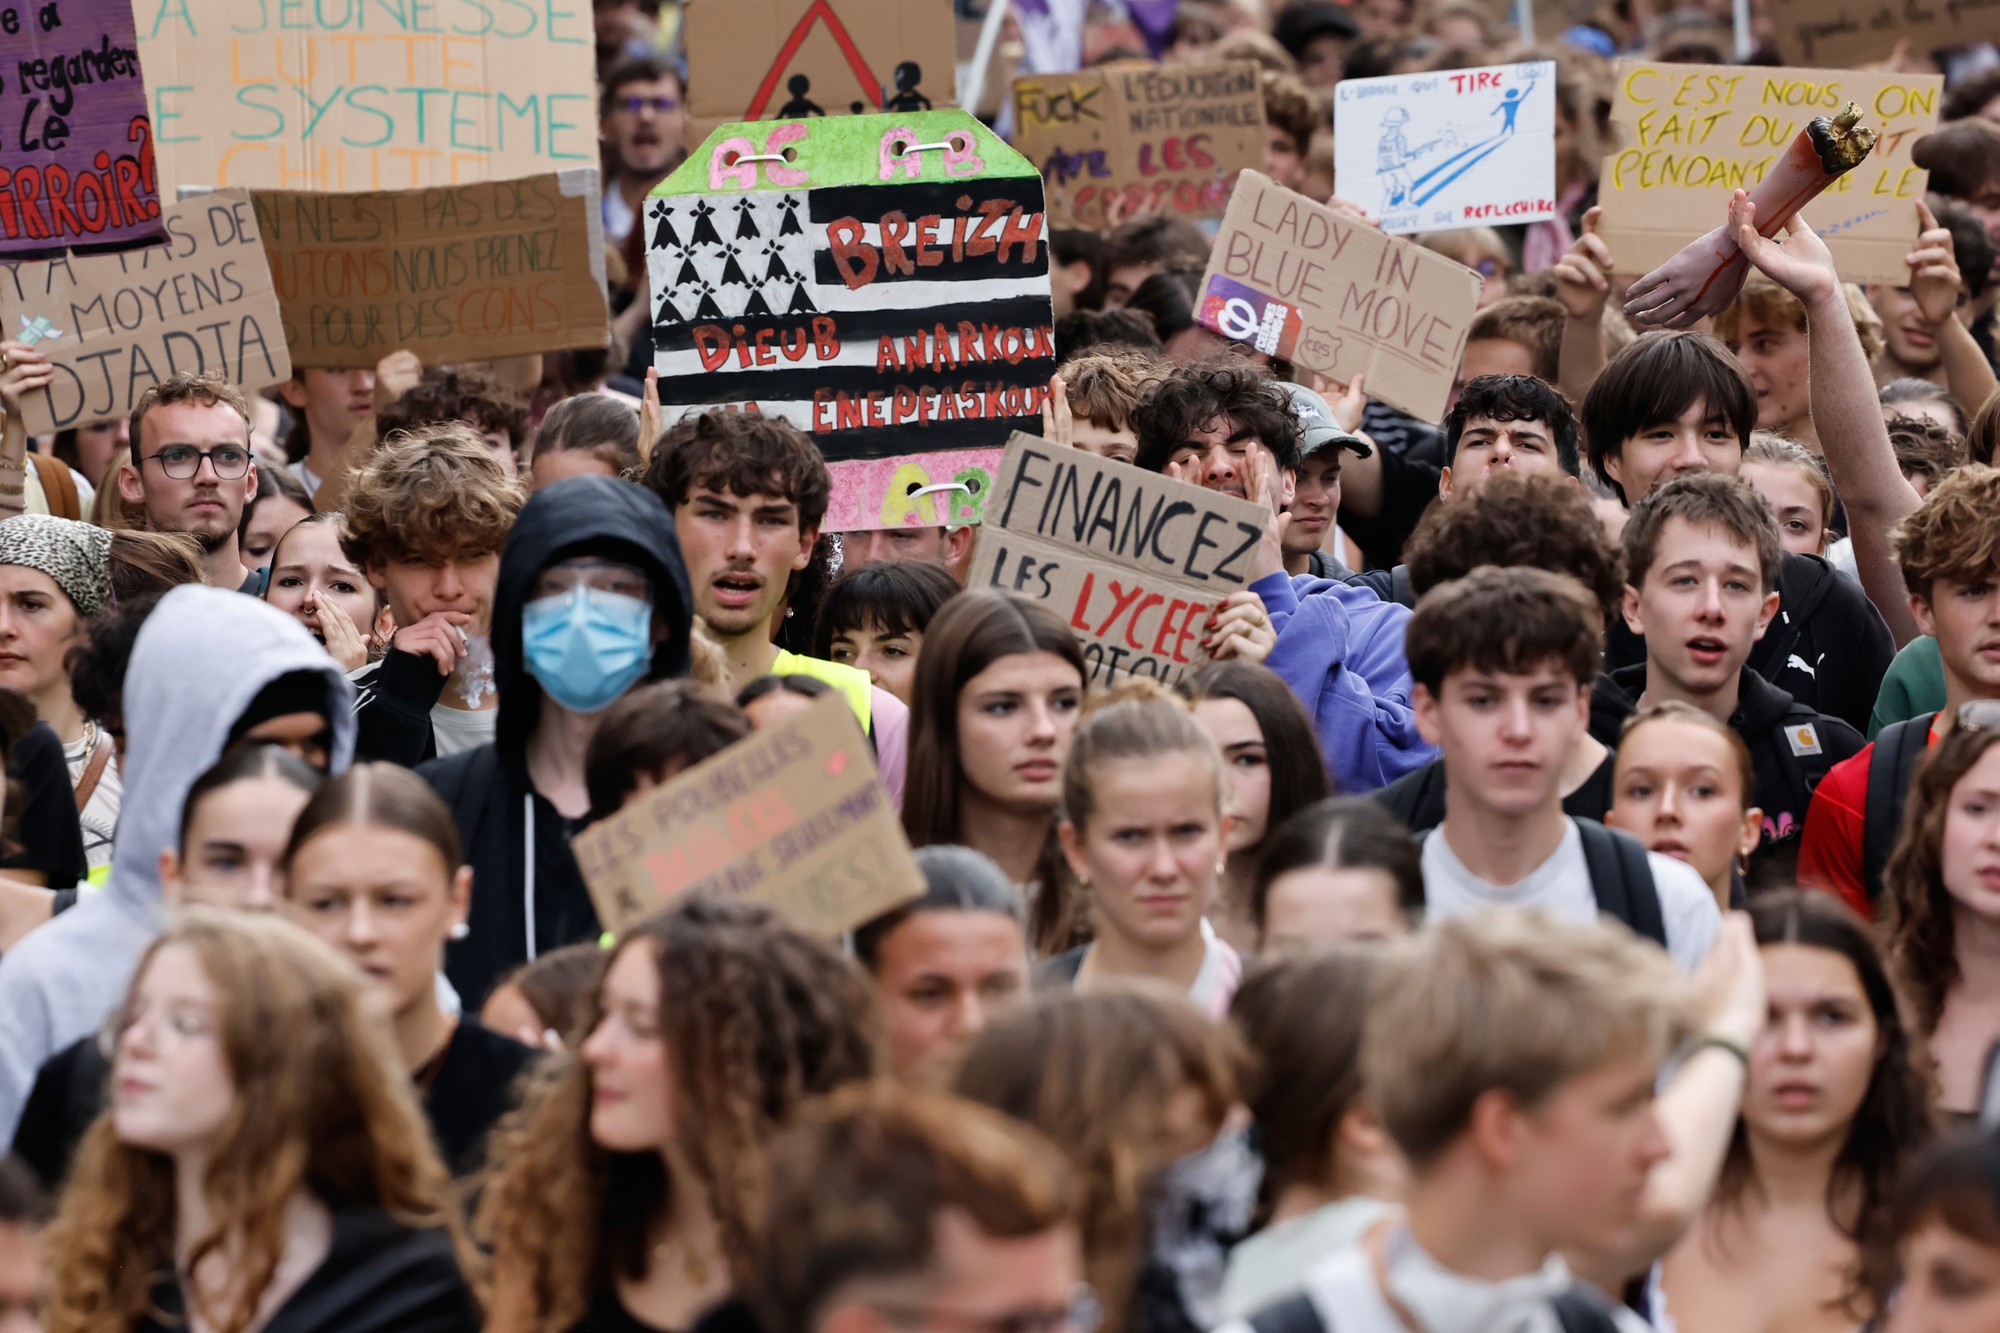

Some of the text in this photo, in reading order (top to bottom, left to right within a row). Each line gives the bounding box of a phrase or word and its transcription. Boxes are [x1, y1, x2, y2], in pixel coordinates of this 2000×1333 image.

[231, 0, 587, 44] JEUNESSE
[18, 34, 138, 116] regarder
[232, 35, 488, 92] LUTTE
[1624, 68, 1936, 119] C'EST NOUS ON
[230, 83, 590, 159] SYSTEME
[1737, 113, 1795, 148] DU
[1138, 133, 1215, 177] LES
[1611, 148, 1774, 191] PENDANT
[1871, 166, 1922, 198] LE
[207, 201, 256, 247] DE
[254, 192, 281, 242] N
[421, 186, 482, 231] PAS
[493, 180, 559, 223] DES
[1251, 188, 1353, 261] LADY
[1375, 239, 1419, 294] IN
[393, 240, 469, 295] NOUS
[475, 228, 563, 281] PRENEZ
[1223, 230, 1326, 310] BLUE
[70, 261, 244, 343] MOYENS
[309, 302, 387, 350] POUR
[396, 297, 454, 343] DES
[457, 278, 563, 338] CONS
[1000, 449, 1263, 584] FINANCEZ
[989, 546, 1060, 599] LES
